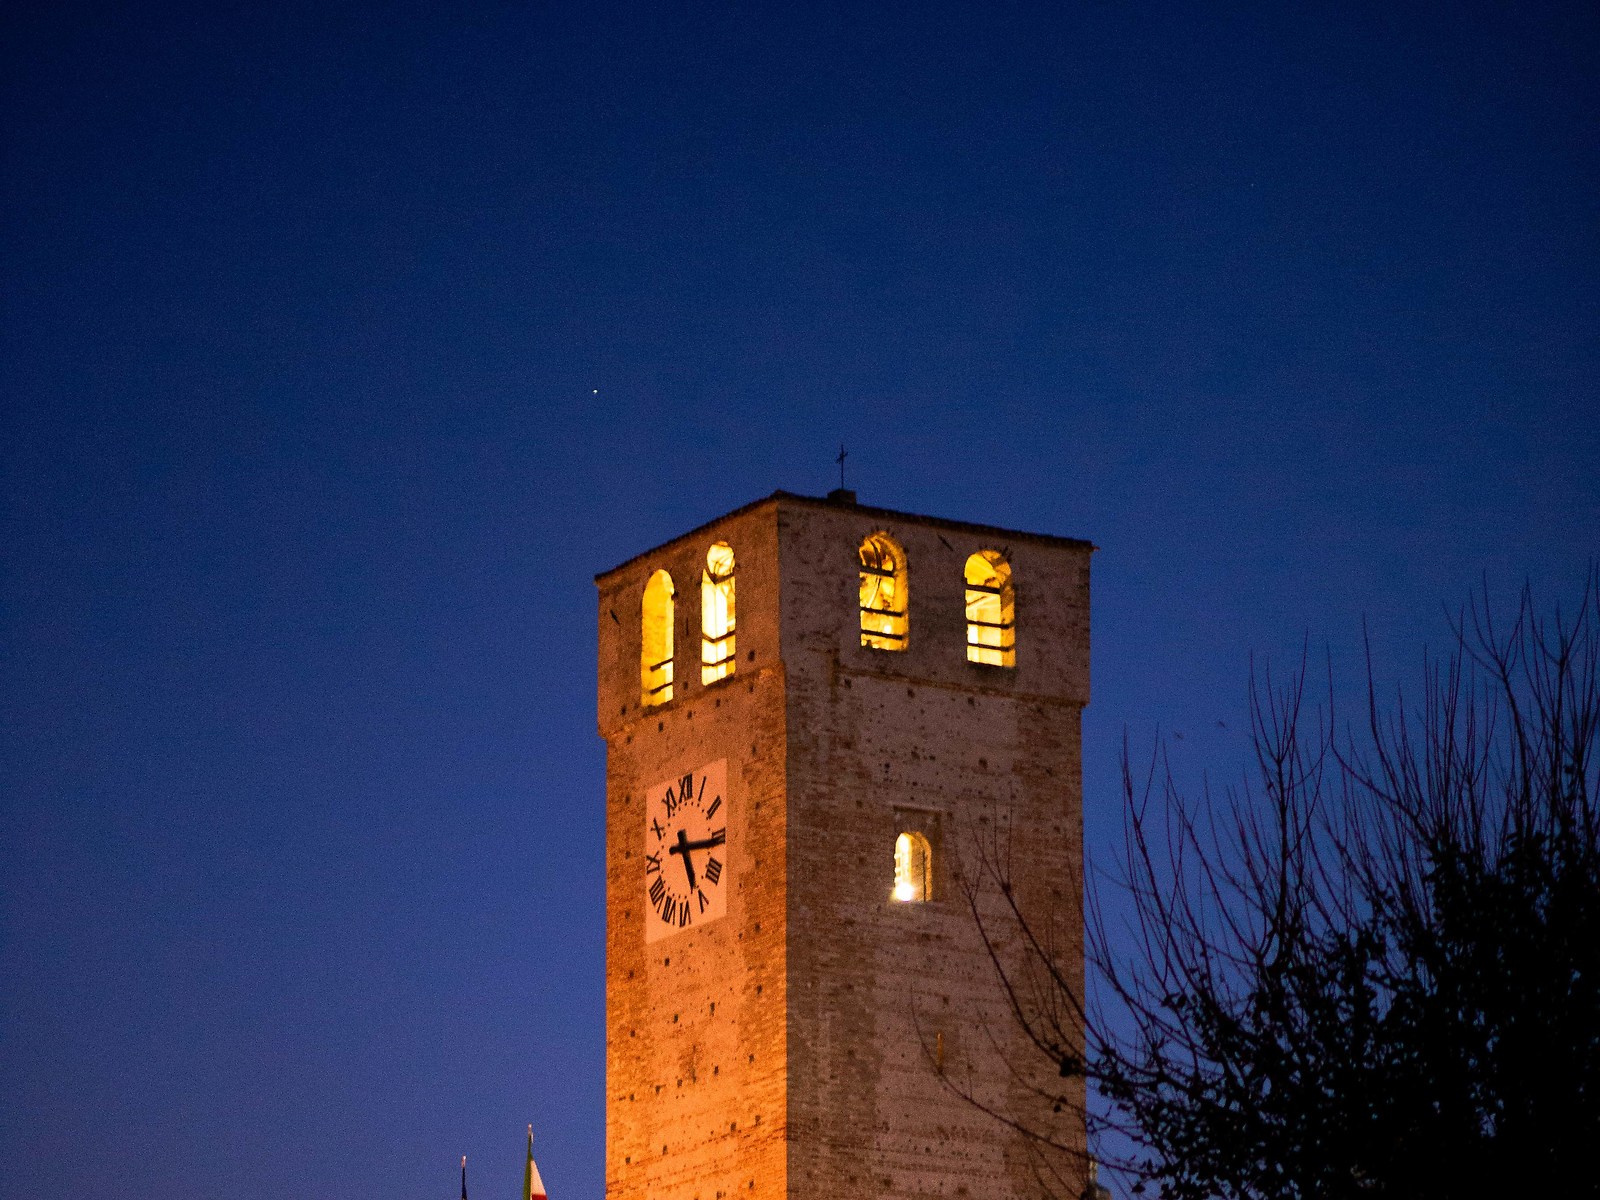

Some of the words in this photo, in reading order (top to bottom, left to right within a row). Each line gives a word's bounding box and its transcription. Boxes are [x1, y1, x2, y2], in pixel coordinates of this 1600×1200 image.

[678, 773, 693, 804] XII
[698, 775, 706, 802] I
[661, 786, 677, 819] XI
[706, 795, 722, 819] II
[650, 817, 665, 841] X
[646, 851, 660, 875] IX
[679, 899, 692, 928] VI
[698, 889, 709, 915] V
